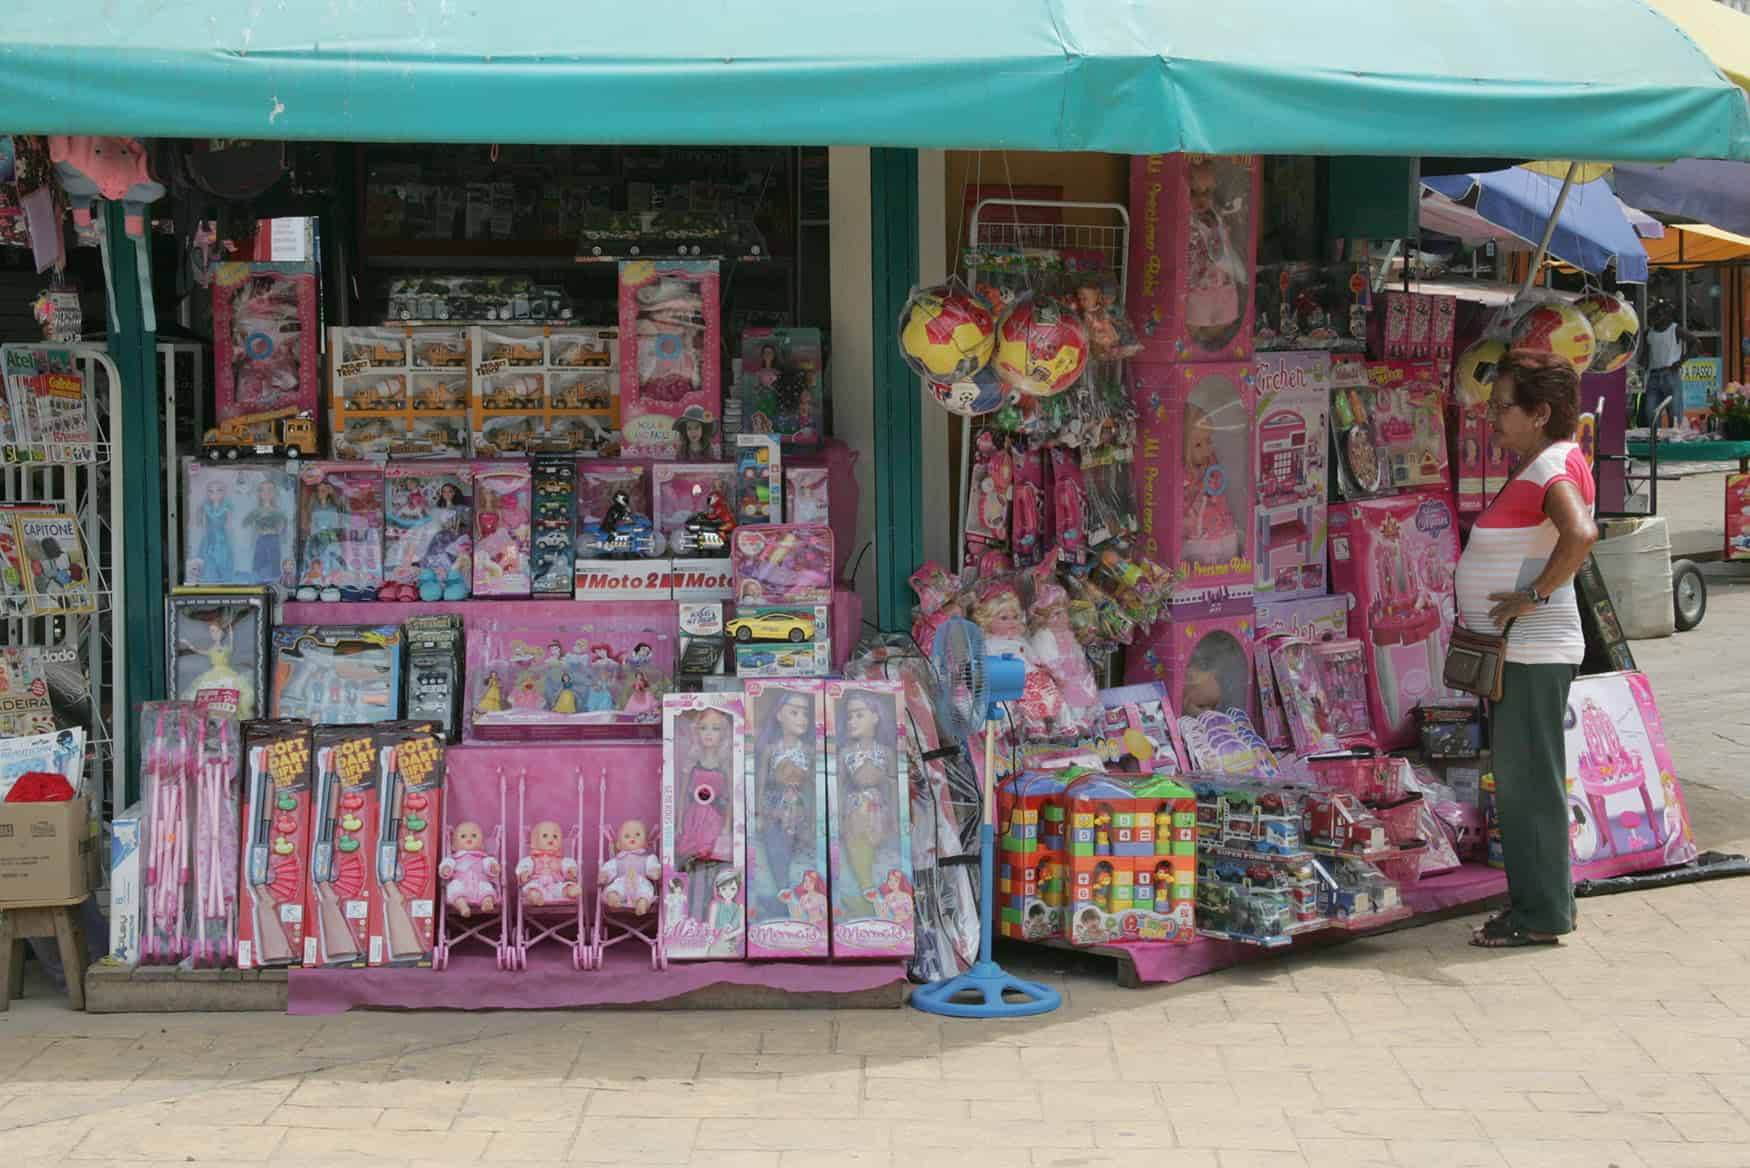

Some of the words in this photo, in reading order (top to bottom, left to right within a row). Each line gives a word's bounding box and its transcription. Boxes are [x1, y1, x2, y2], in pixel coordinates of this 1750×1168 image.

[588, 573, 643, 590] Moto
[645, 571, 659, 589] 2
[269, 749, 309, 770] DART
[336, 748, 376, 770] DART
[399, 748, 438, 769] DART
